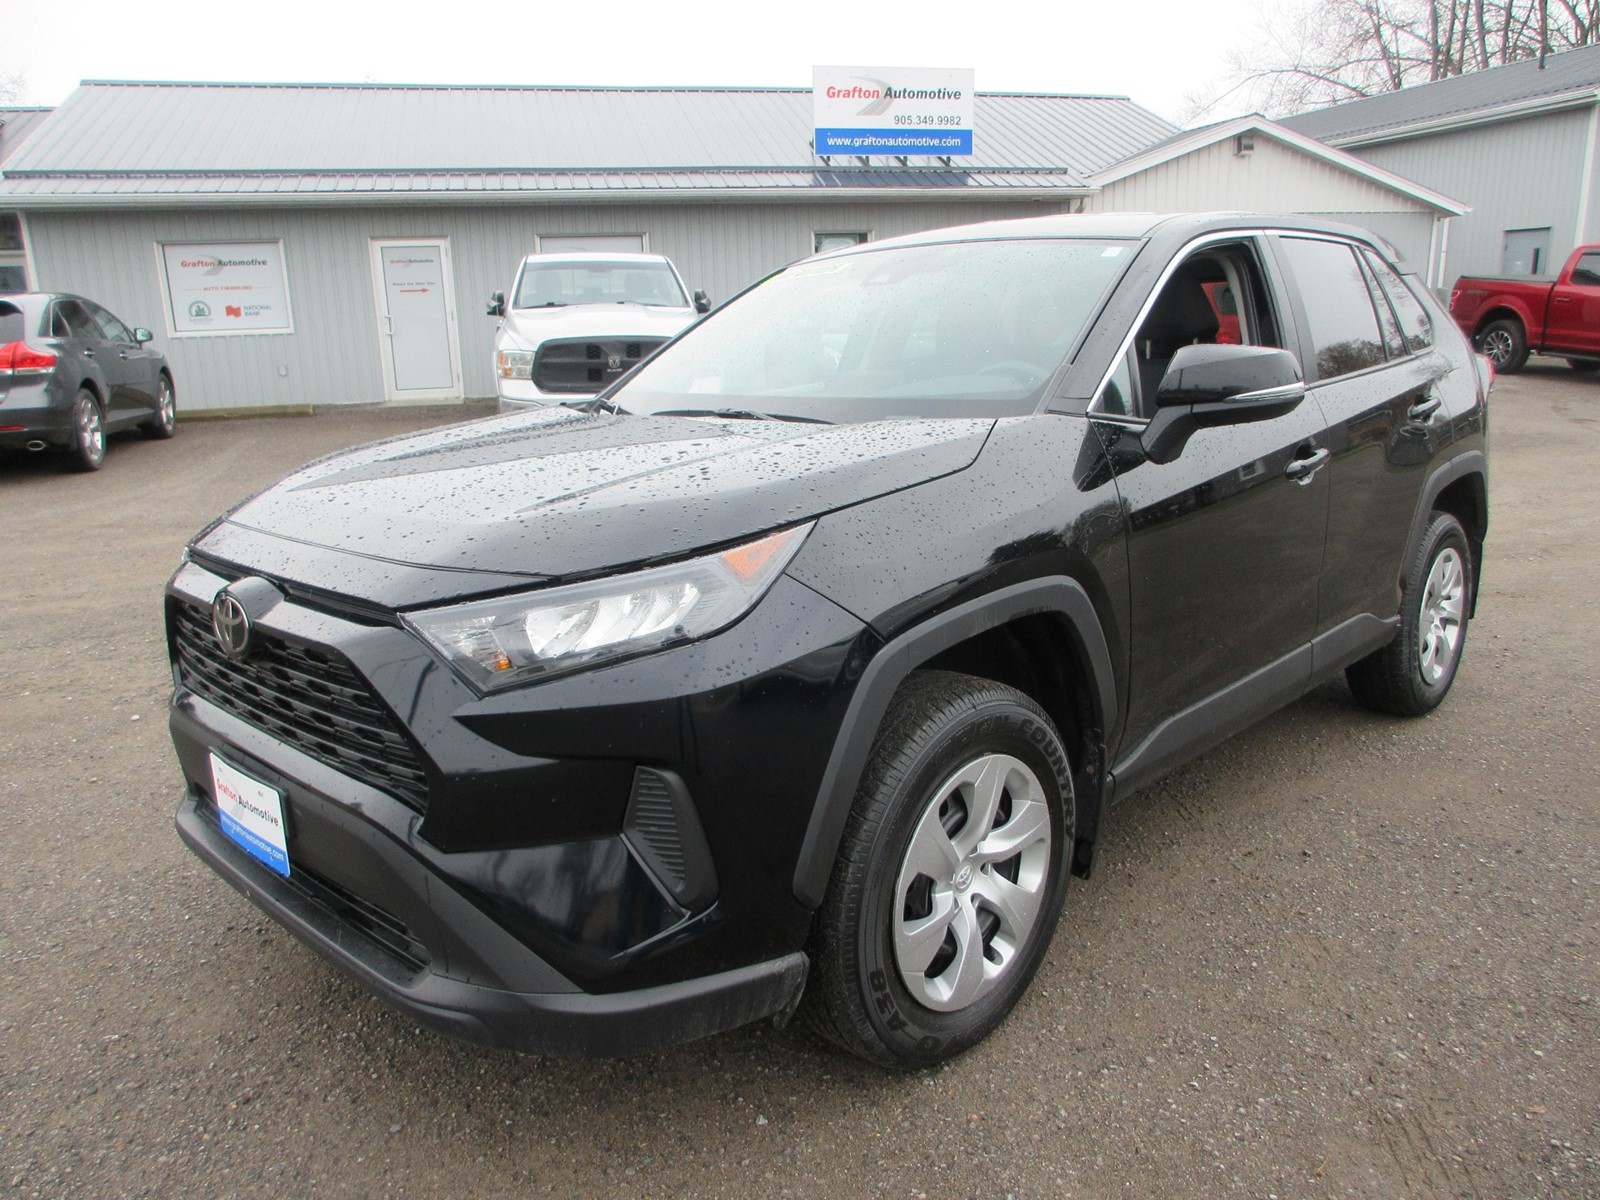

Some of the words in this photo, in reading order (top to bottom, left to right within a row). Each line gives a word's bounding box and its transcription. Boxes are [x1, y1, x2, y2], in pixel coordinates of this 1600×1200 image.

[826, 86, 880, 99] Grafton
[884, 87, 962, 100] Automotive
[894, 115, 962, 126] 905.349.9982
[827, 136, 961, 147] www.graftonautomotive.com
[181, 259, 216, 269] Grafton
[217, 259, 268, 268] Automotive
[216, 778, 238, 802] Grafton
[239, 795, 279, 827] Automotive
